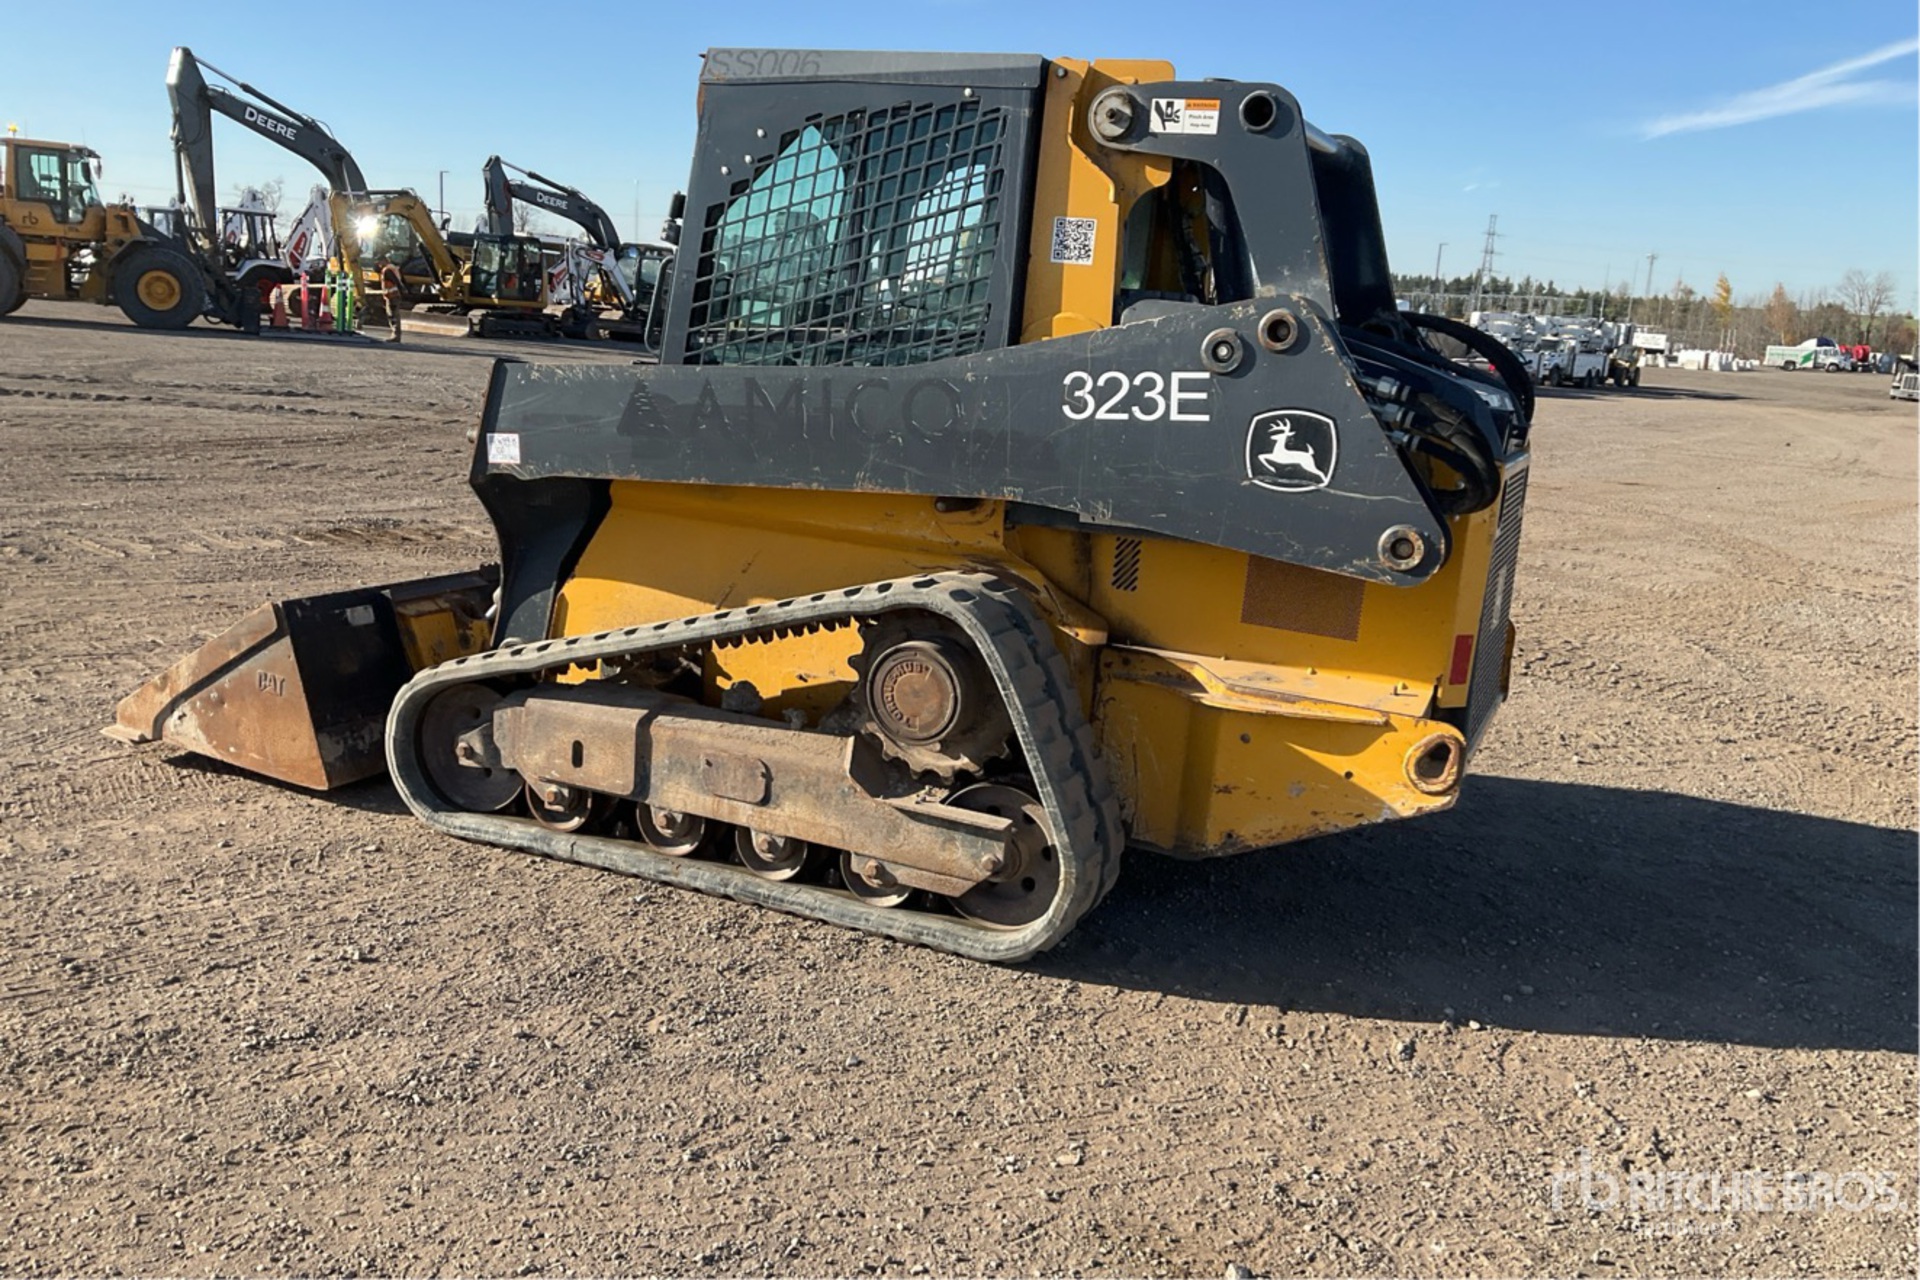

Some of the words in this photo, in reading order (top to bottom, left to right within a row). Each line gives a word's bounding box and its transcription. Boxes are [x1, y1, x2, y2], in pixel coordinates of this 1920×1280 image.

[245, 106, 297, 141] DEERE
[22, 211, 39, 225] rb
[536, 192, 568, 210] DEERE
[687, 376, 966, 443] AMICO
[1062, 370, 1211, 422] 323E
